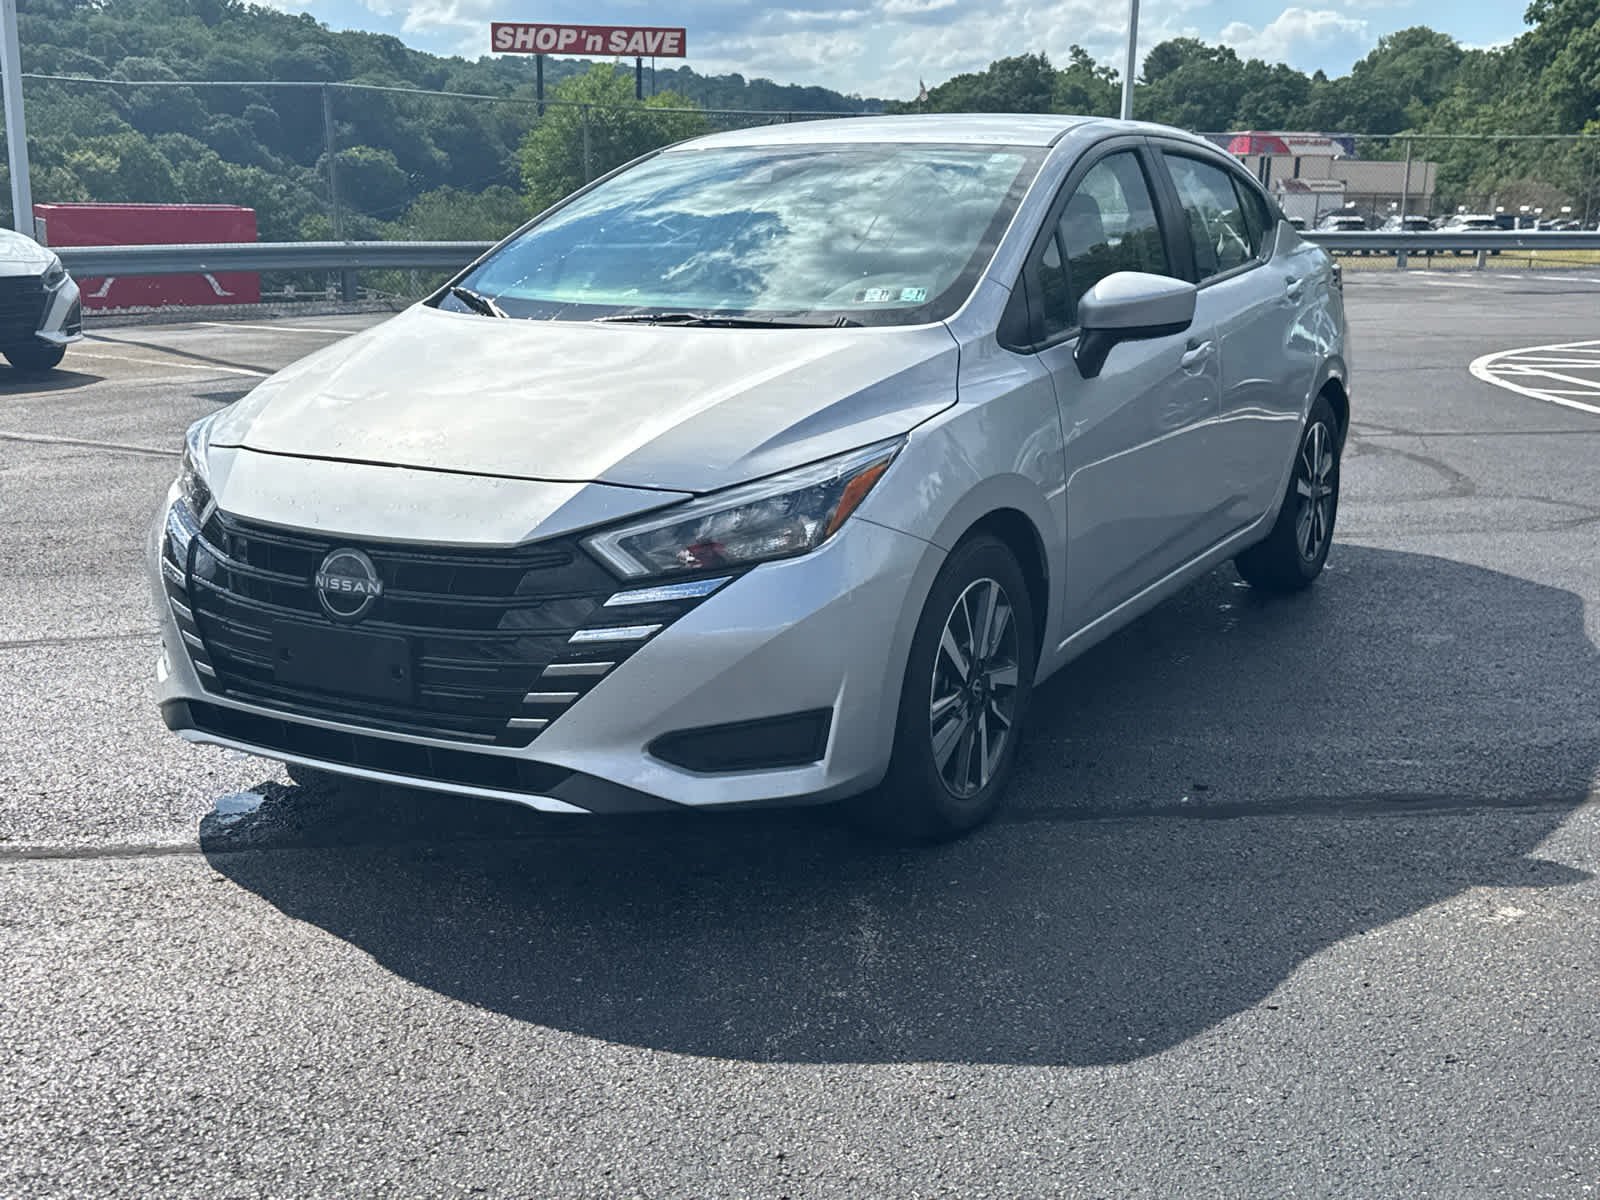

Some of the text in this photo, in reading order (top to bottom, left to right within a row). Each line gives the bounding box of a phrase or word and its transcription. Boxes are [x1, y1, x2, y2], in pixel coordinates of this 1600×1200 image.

[495, 26, 578, 50] SHOP
[608, 30, 682, 54] SAVE
[315, 575, 381, 594] NISSAN
